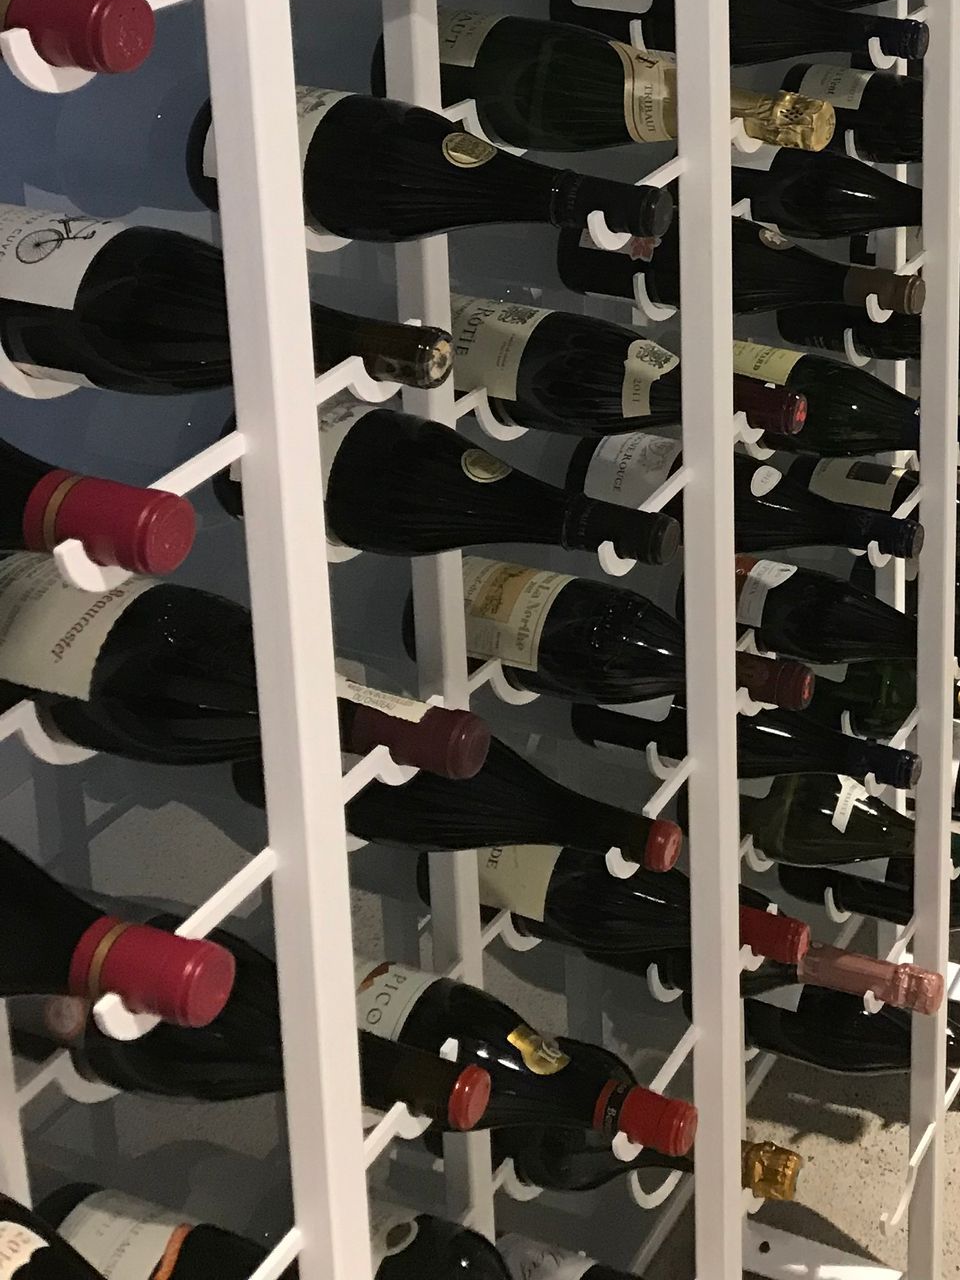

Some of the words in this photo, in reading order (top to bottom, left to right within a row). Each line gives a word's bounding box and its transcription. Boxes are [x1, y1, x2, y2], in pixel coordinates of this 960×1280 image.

[644, 83, 656, 133] TRIBAUT
[632, 376, 643, 403] 2011
[51, 587, 125, 661] Beaucastel
[366, 973, 408, 1025] PICO
